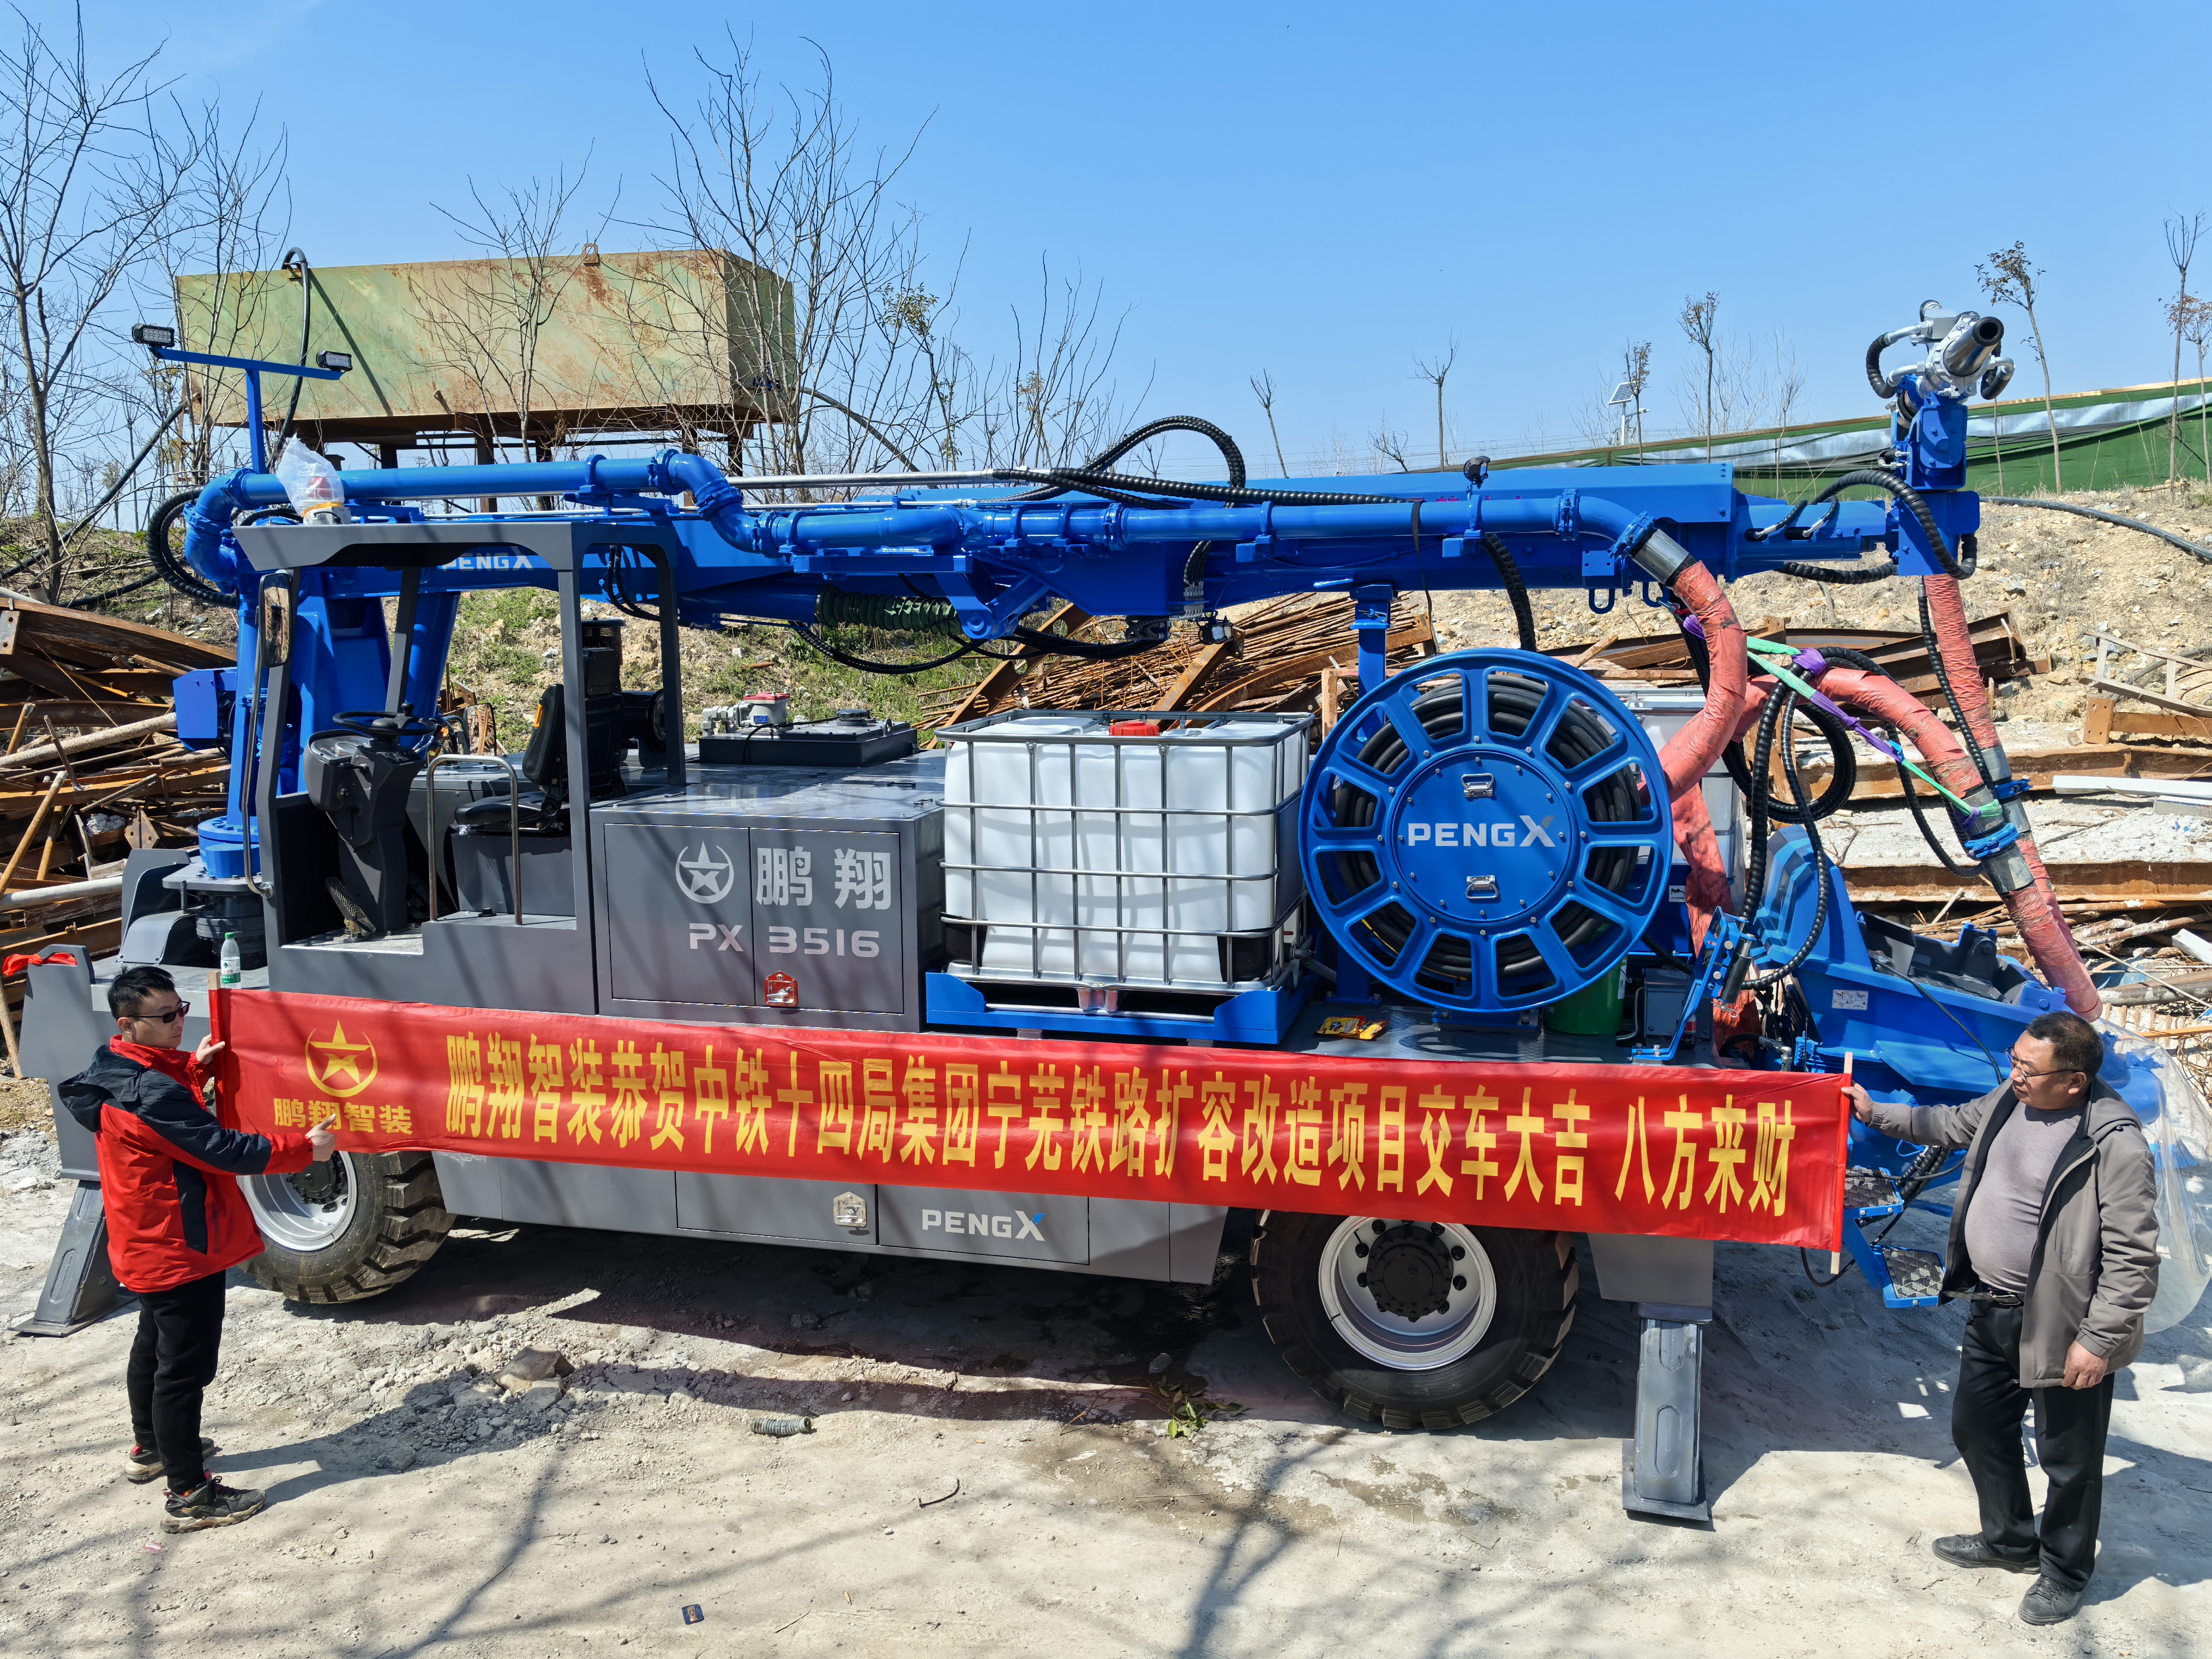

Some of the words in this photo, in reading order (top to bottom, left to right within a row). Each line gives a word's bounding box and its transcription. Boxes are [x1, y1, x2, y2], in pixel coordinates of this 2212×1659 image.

[1408, 815, 1556, 847] PENGX
[756, 846, 892, 910] 鹏翔
[689, 922, 744, 952] PX
[769, 926, 880, 958] 3516
[273, 1097, 413, 1135] 鹏翔智装
[446, 1031, 1590, 1206] 鹏翔智装恭贺中铁十四局集团宁芜铁路扩容改造项目交车大吉
[1615, 1093, 1796, 1217] 八方来财
[922, 1209, 1046, 1242] PENGX
